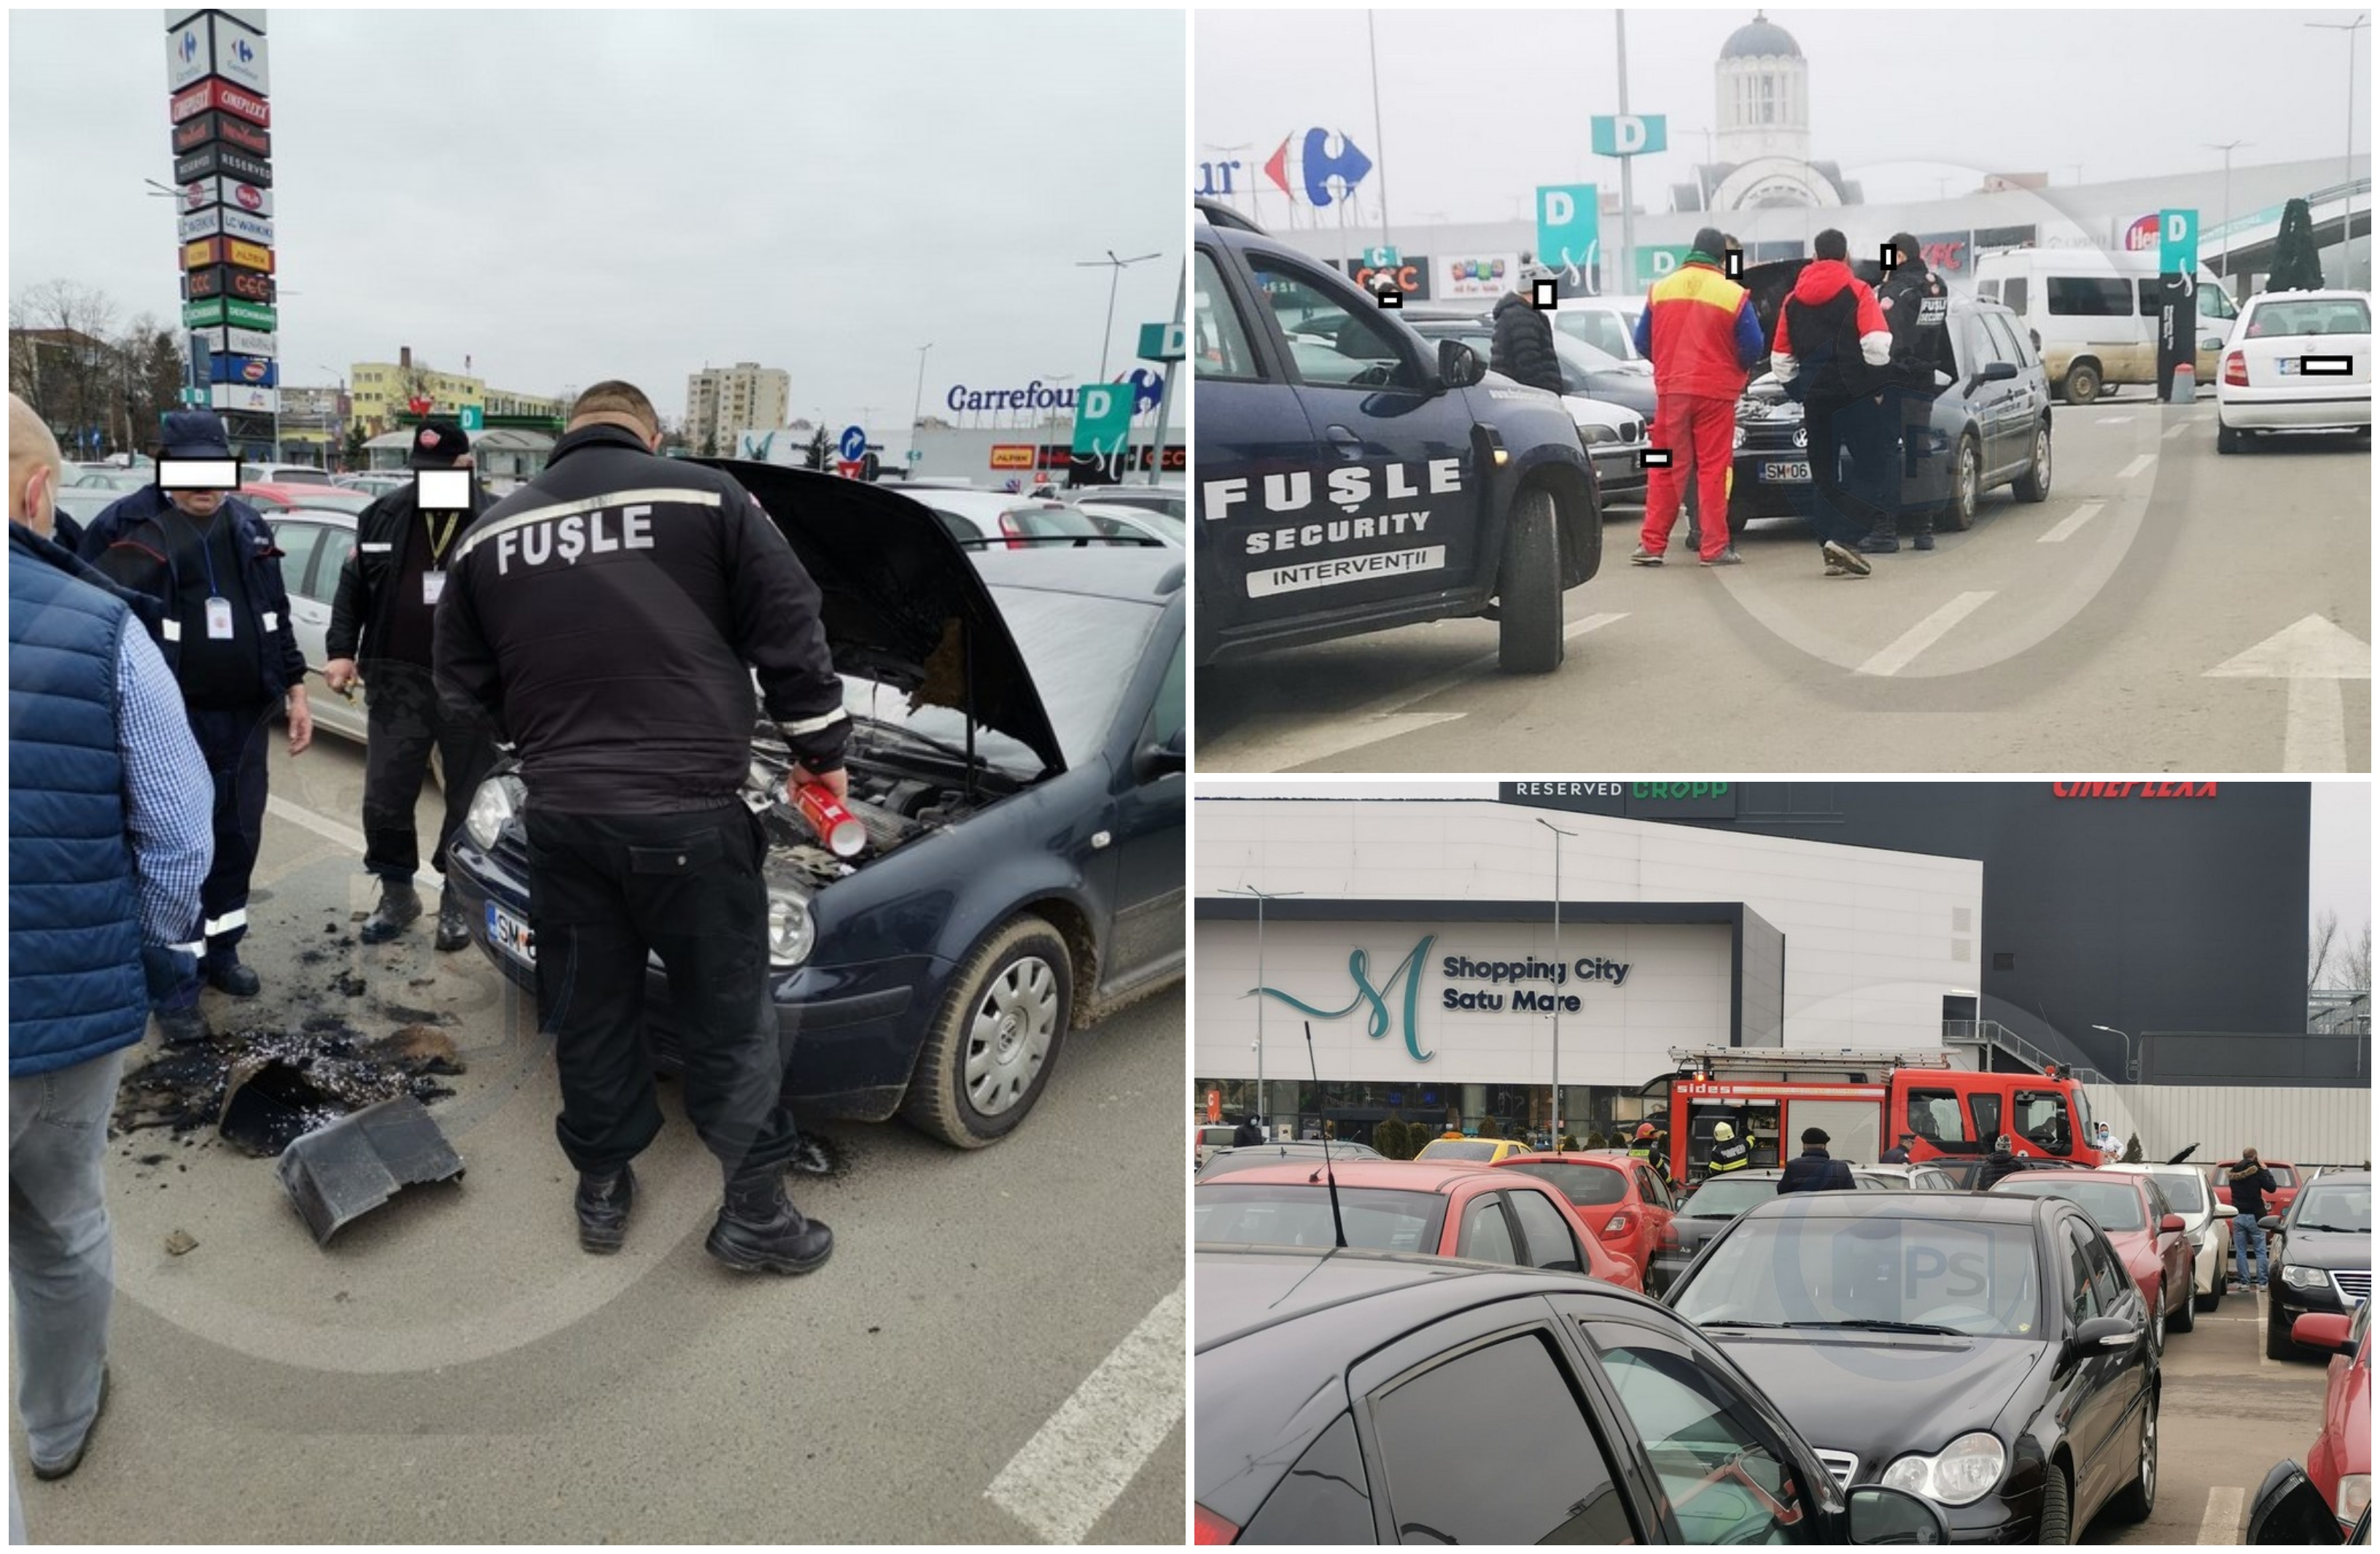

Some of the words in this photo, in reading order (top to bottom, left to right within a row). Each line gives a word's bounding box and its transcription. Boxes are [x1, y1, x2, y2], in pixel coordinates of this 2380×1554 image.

[1614, 117, 1646, 152] D
[221, 153, 272, 179] RESERVED
[1545, 192, 1575, 225] D
[2168, 214, 2187, 242] D
[1653, 251, 1676, 273] D
[235, 275, 268, 296] CCC
[1356, 265, 1419, 291] CC
[1085, 390, 1111, 419] D
[1792, 464, 1808, 478] 06
[1203, 458, 1462, 521] FUȘLE
[497, 505, 655, 575] FUȘLE
[1245, 510, 1431, 554] SECURITY
[1272, 550, 1427, 586] INTERVENȚII
[1517, 782, 1622, 796] RESERVED
[1632, 782, 1729, 800] CROPP
[2053, 782, 2217, 799] CINEPLEXX
[1442, 955, 1567, 984] Shopping
[1574, 957, 1630, 985] City
[1442, 987, 1504, 1011] Satu
[1512, 990, 1582, 1012] Mare
[1676, 1083, 1730, 1094] sides
